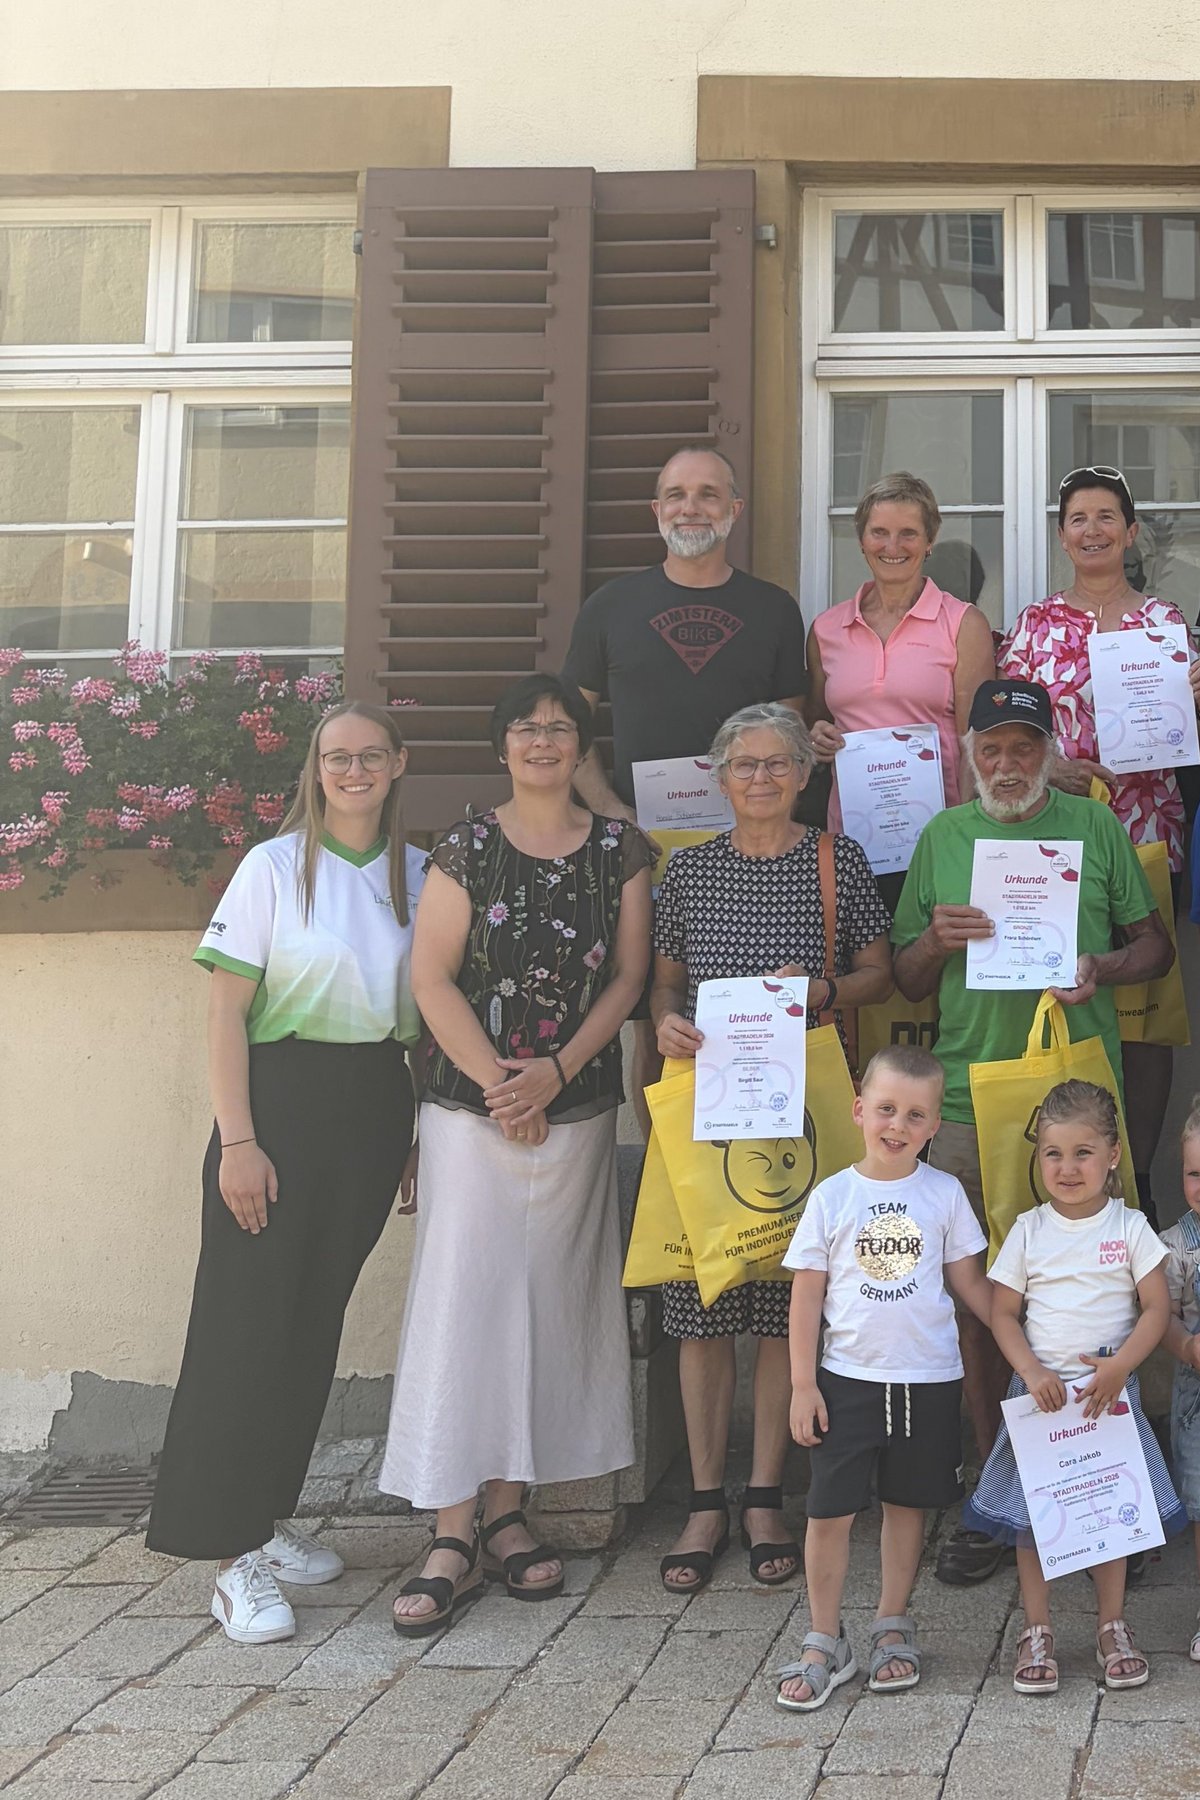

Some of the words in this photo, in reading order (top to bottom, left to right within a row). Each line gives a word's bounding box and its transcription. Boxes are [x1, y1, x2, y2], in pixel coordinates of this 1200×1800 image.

[653, 607, 740, 632] ZIMTSTERN
[678, 628, 716, 640] BIKE
[1121, 660, 1160, 672] Urkunde
[867, 760, 907, 773] Urkunde
[667, 789, 709, 800] Urkunde
[1004, 875, 1048, 884] Urkunde
[728, 1012, 773, 1024] Urkunde
[868, 1202, 907, 1216] TEAM
[738, 1218, 783, 1241] PREMIUM
[664, 1243, 682, 1254] FÜR
[684, 1247, 693, 1256] IN
[725, 1245, 745, 1259] FÜR
[860, 1278, 919, 1302] GERMANY
[1049, 1421, 1097, 1443] Urkunde
[1059, 1457, 1077, 1468] Cara
[1078, 1450, 1102, 1463] Jakob
[1052, 1477, 1103, 1498] STADTRADELN
